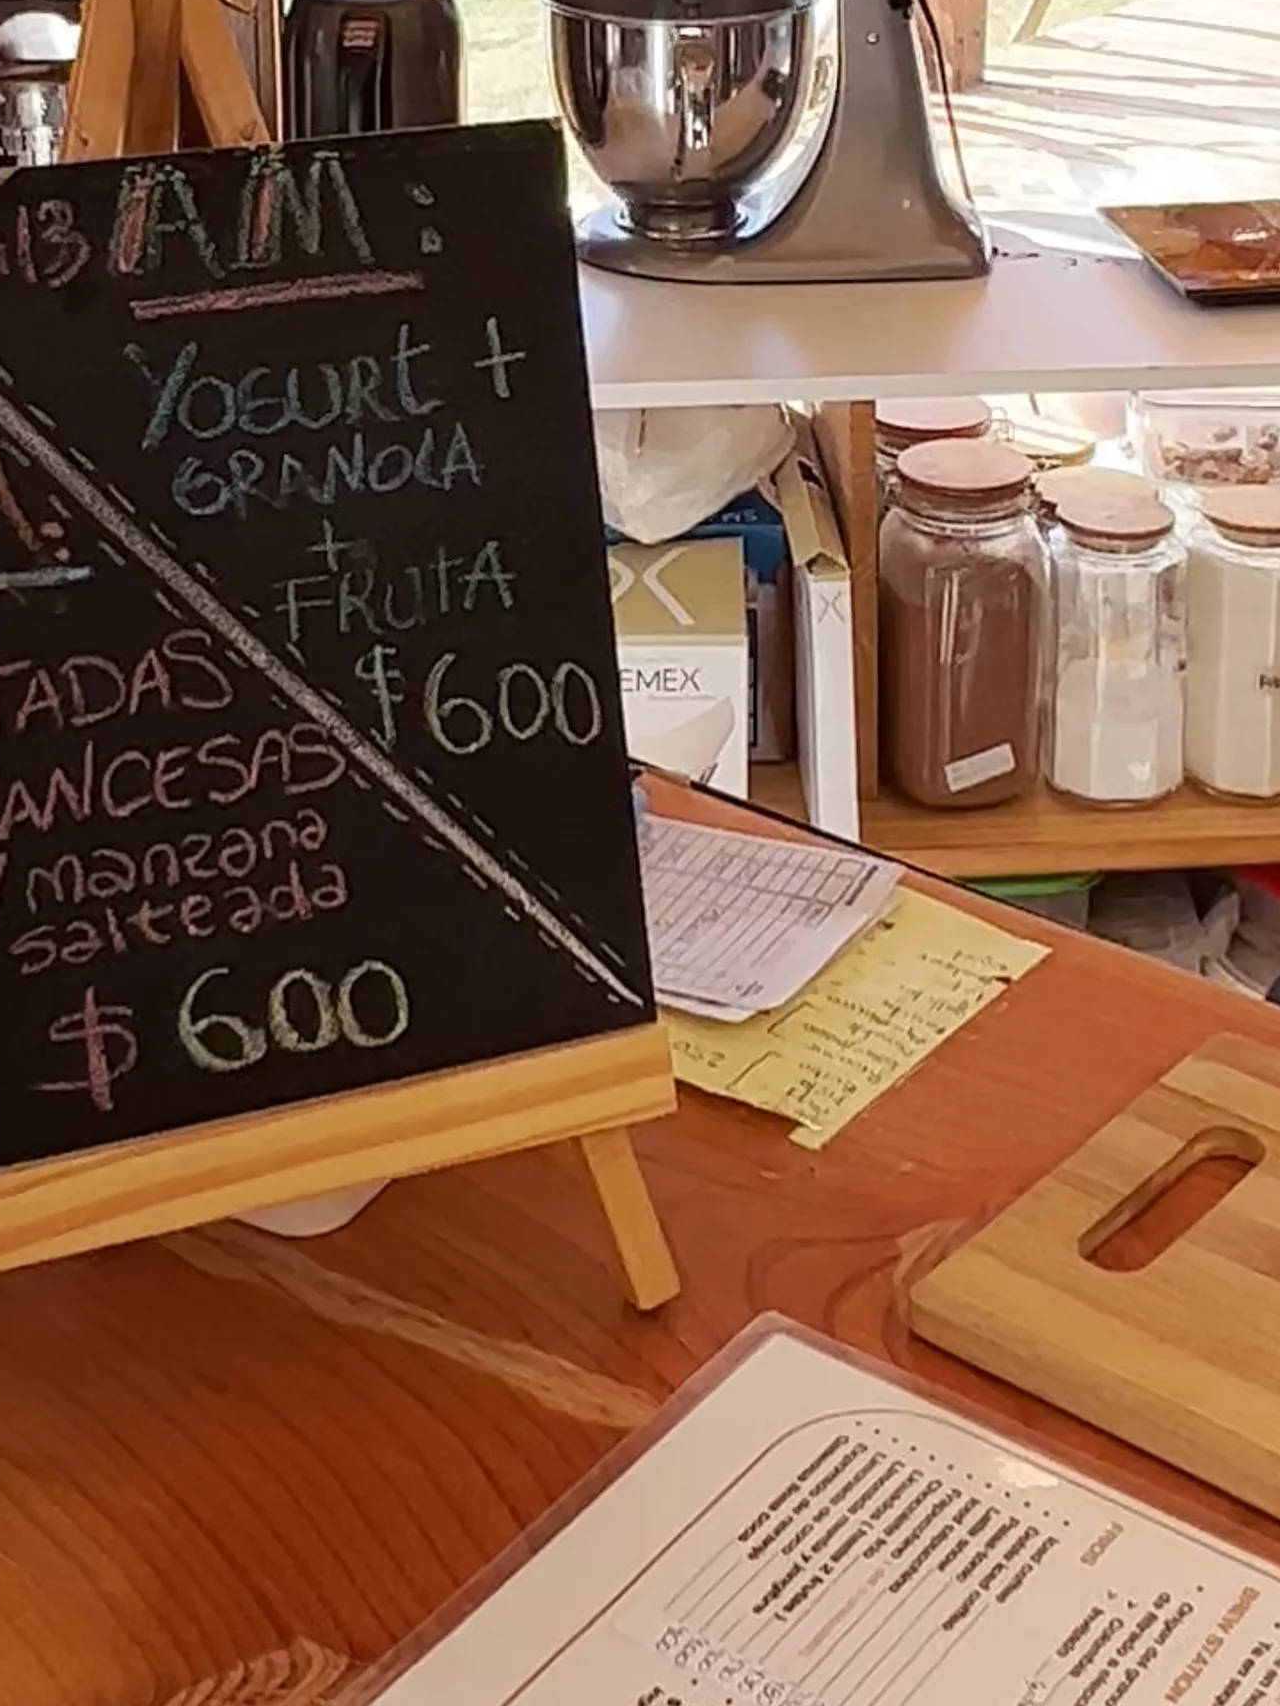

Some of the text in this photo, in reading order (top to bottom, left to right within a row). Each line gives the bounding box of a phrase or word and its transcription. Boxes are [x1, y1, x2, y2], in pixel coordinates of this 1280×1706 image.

[172, 420, 485, 519] GRANOLA
[619, 667, 702, 692] EMEX
[8, 859, 350, 977] salteada
[1151, 1590, 1172, 1611] de
[1162, 1584, 1261, 1705] BREW STATION
